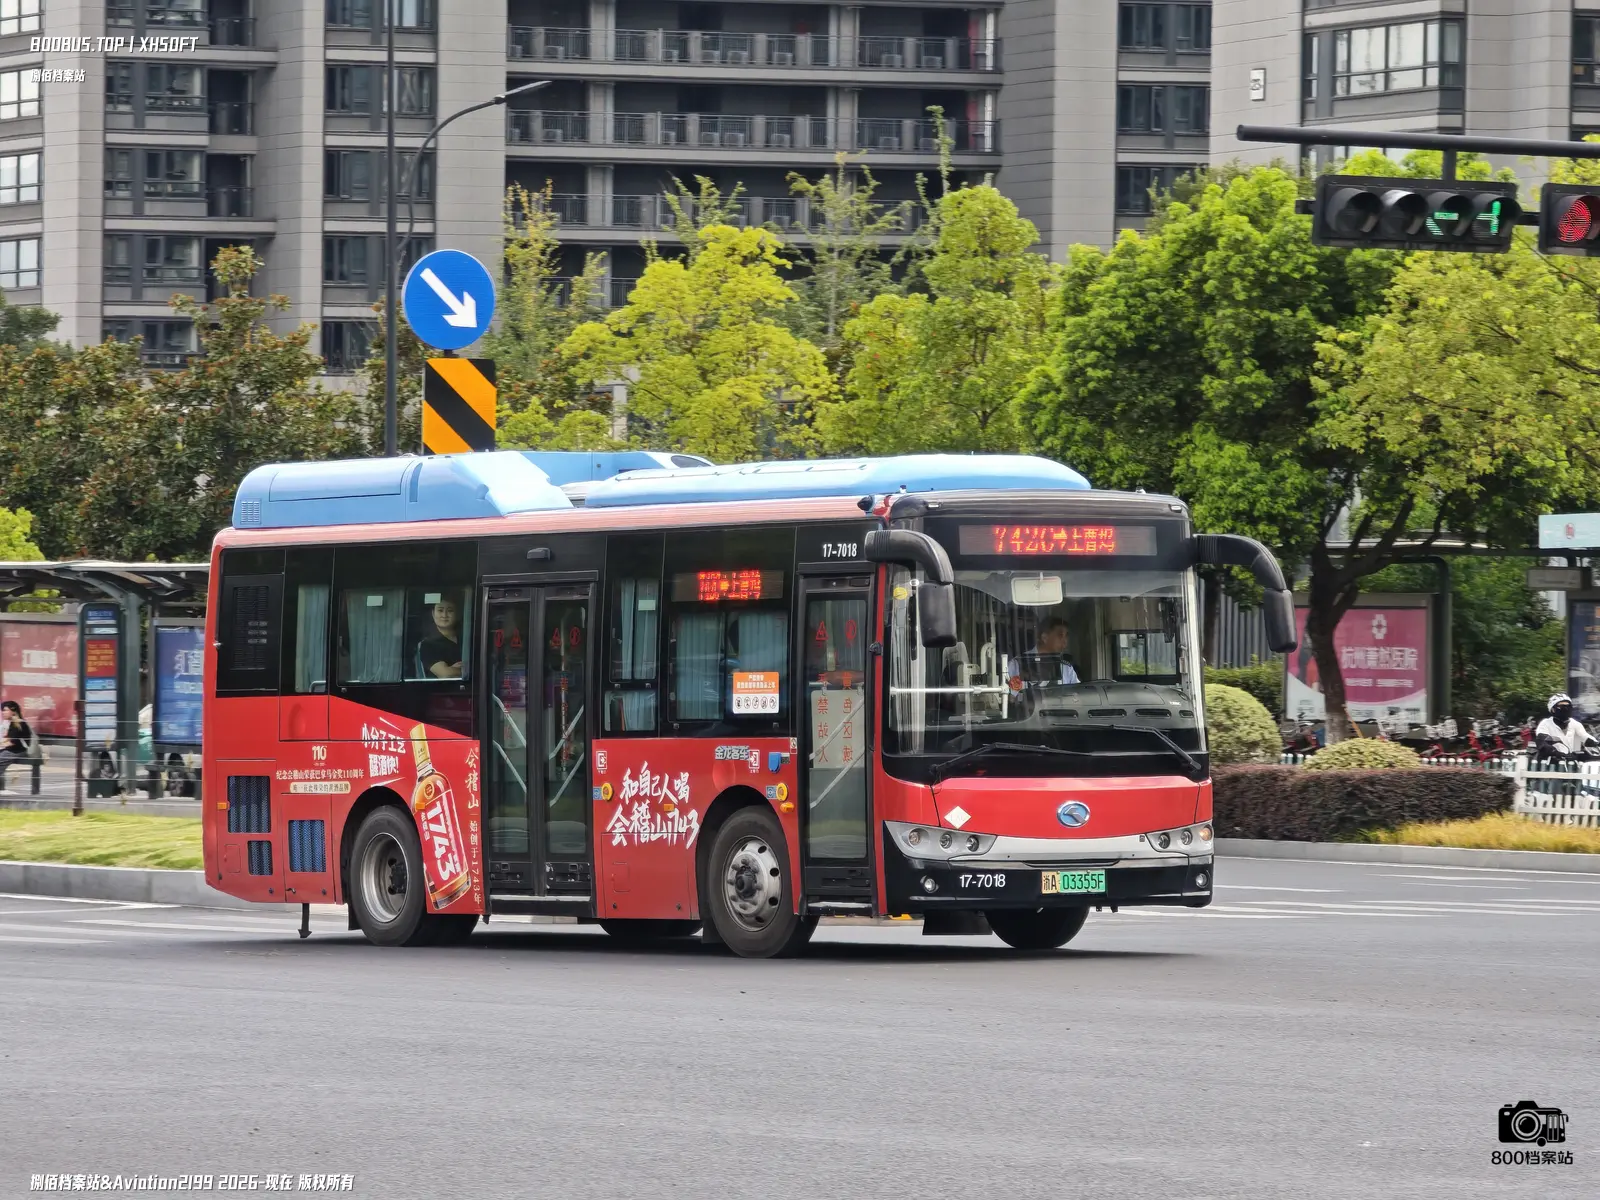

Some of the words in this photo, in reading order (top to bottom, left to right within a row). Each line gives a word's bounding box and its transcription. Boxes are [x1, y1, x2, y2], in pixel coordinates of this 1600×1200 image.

[823, 543, 857, 557] 17-7018
[362, 723, 405, 753] 小分子工艺
[715, 746, 749, 760] 金龙客车
[464, 748, 479, 809] 会稽山
[620, 761, 690, 805] 和自己人喝
[606, 799, 699, 850] 会稽山1743
[426, 801, 456, 881] 1743
[959, 874, 1006, 888] 17-7018
[1063, 873, 1104, 890] 03355F
